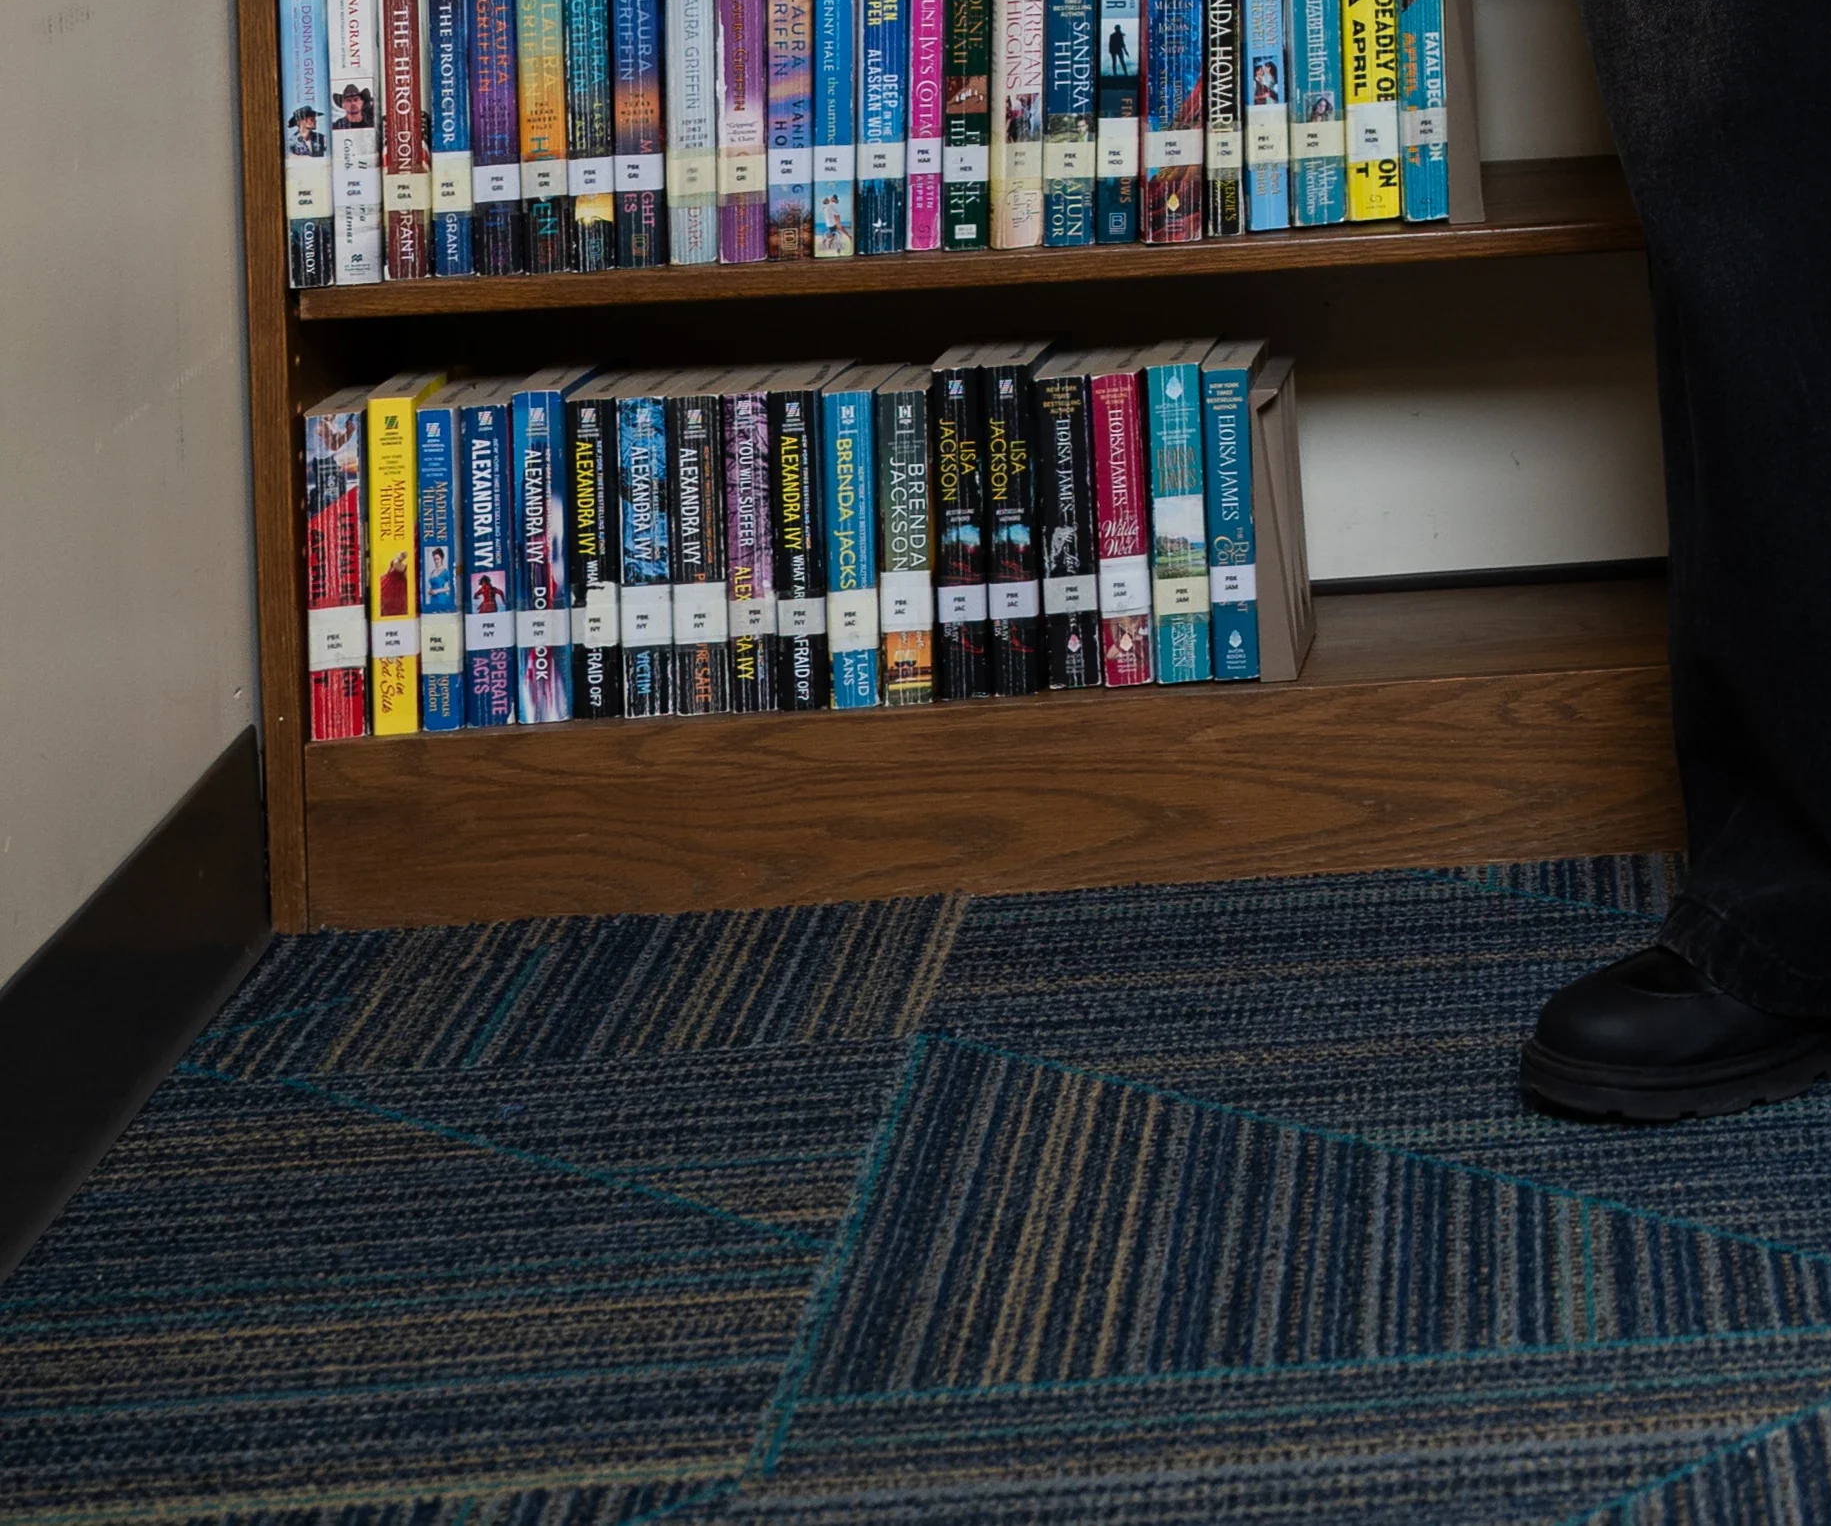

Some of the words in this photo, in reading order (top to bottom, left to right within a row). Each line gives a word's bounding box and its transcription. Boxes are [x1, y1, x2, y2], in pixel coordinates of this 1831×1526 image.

[393, 8, 409, 47] THE
[440, 2, 452, 36] THE
[1007, 0, 1022, 89] HIGGINS
[394, 57, 411, 115] HERO
[1054, 41, 1071, 90] HILL
[1072, 21, 1090, 108] SANDRA
[441, 43, 455, 143] PROTECTOR
[304, 222, 316, 274] COWBOY
[738, 437, 753, 465] YOU
[990, 418, 1008, 500] JACKSON
[1010, 441, 1026, 474] LISA
[1218, 415, 1238, 465] ELOISA
[471, 439, 493, 536] ALEXANDRA
[740, 468, 752, 490] WILL
[1220, 469, 1239, 521] JAMES
[739, 496, 754, 546] SUFFER
[909, 463, 926, 567] BRENDA
[474, 541, 494, 567] IVY
